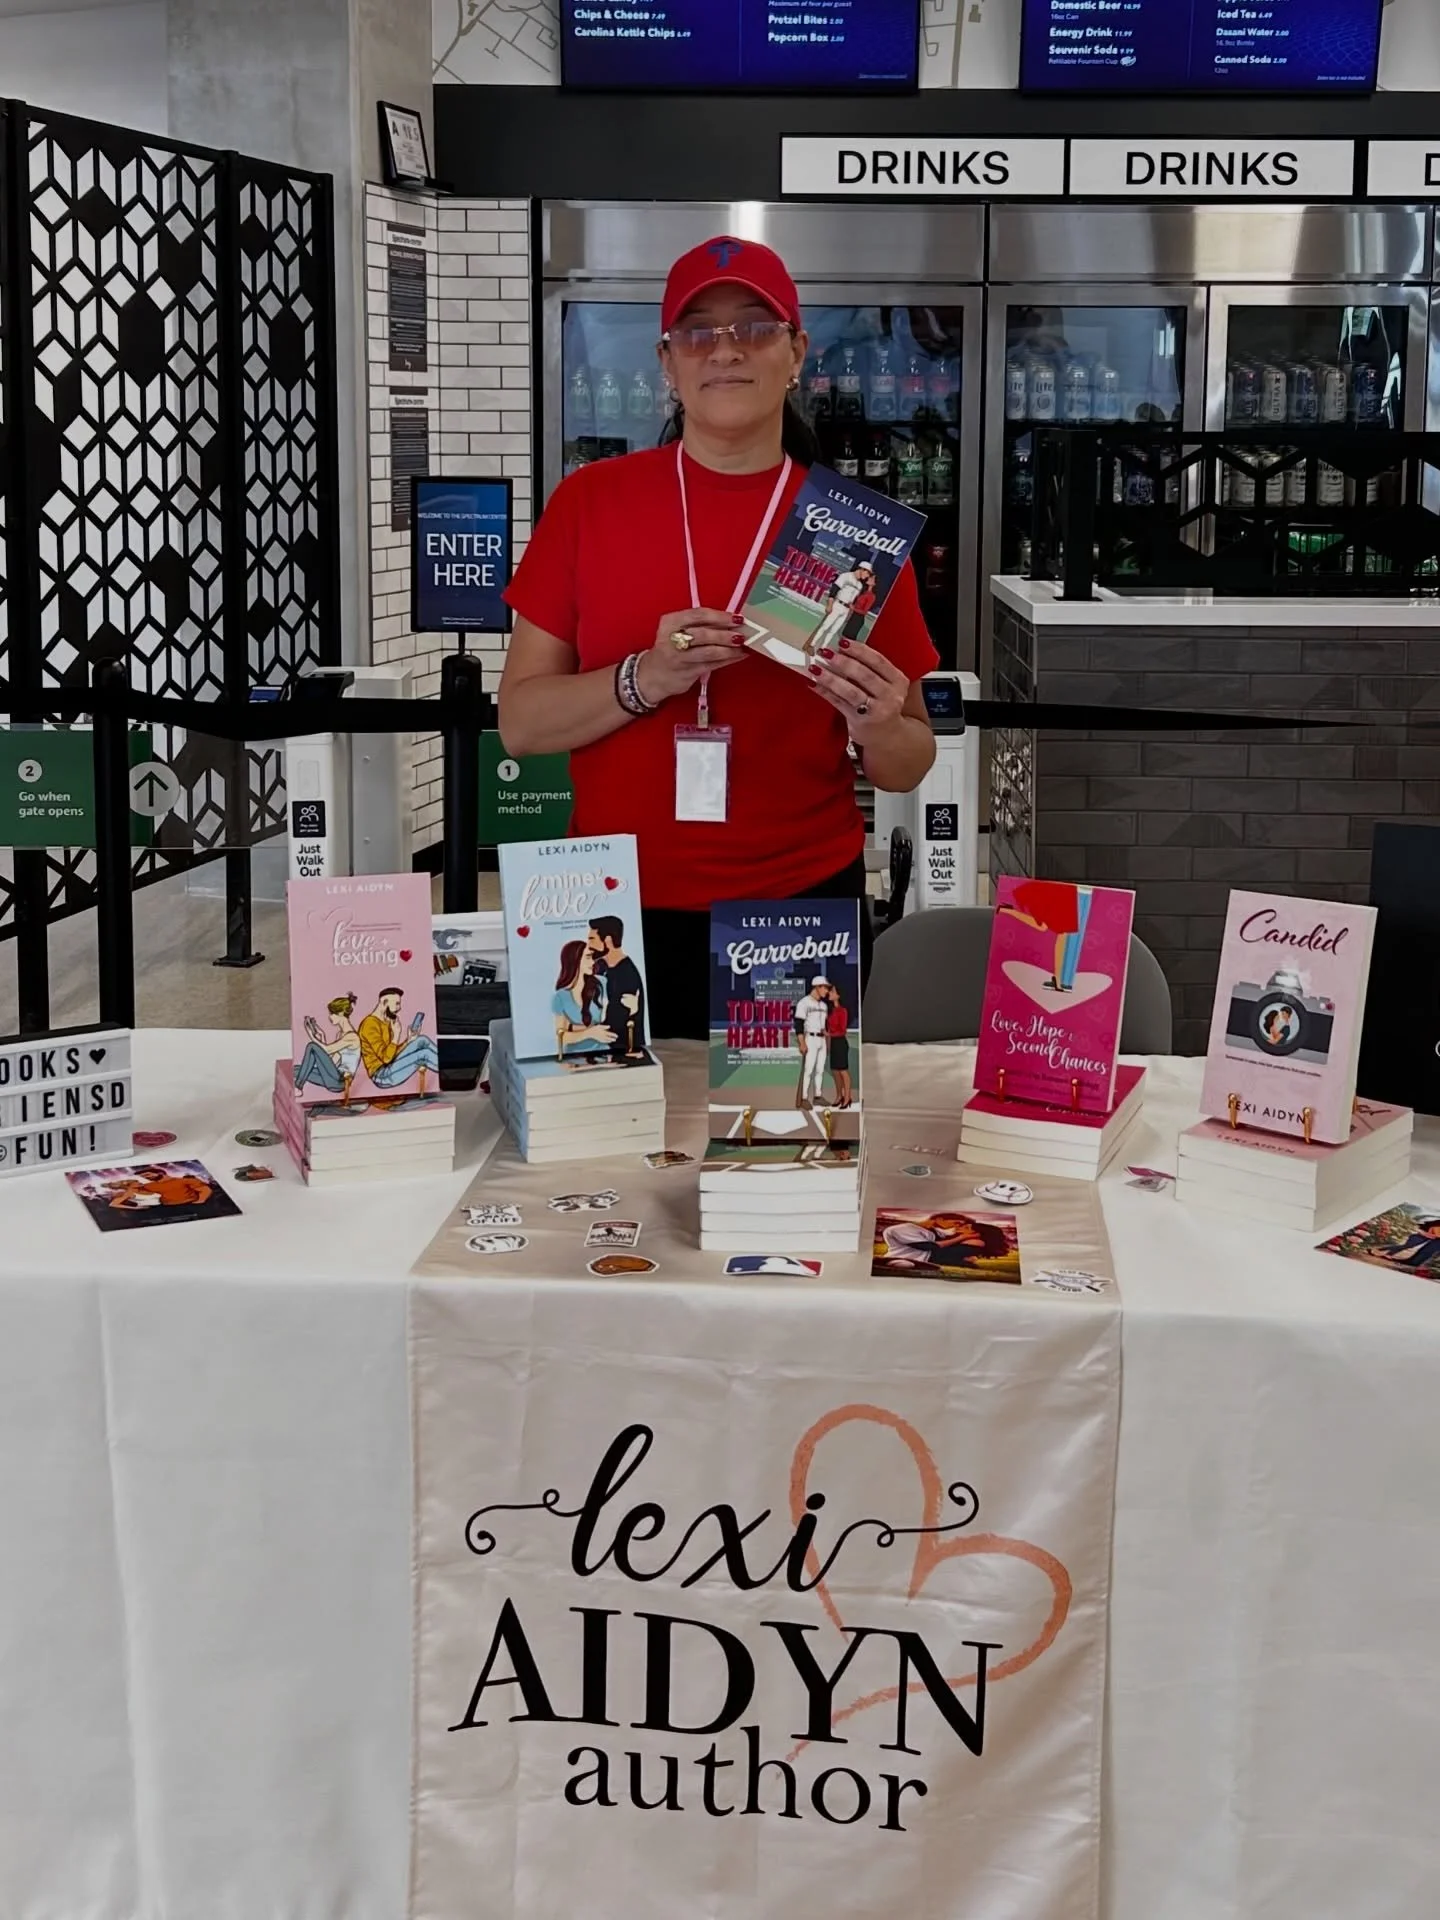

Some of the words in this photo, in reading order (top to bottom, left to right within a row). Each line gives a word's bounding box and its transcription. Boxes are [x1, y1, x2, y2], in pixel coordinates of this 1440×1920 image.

[1051, 0, 1096, 10] Domestic
[1098, 0, 1121, 10] Beer
[574, 9, 602, 21] Chips
[604, 10, 612, 19] &
[614, 10, 650, 20] Cheese
[768, 15, 801, 24] Pretzel
[804, 15, 827, 24] Bites
[1217, 9, 1238, 19] Iced
[1240, 10, 1256, 19] Tea
[575, 27, 614, 37] Carolina
[617, 28, 645, 37] Kettle
[648, 28, 675, 39] Chips
[768, 32, 808, 44] Popcorn
[810, 33, 828, 42] Box
[1050, 27, 1083, 39] Energy
[1086, 27, 1112, 37] Drink
[1216, 28, 1246, 36] Dasani
[1248, 28, 1273, 36] Water
[1049, 45, 1092, 54] Souvenir
[1093, 45, 1118, 54] Soda
[1214, 54, 1247, 63] Canned
[1249, 54, 1271, 63] Soda
[837, 150, 1009, 185] DRINKS
[1125, 151, 1299, 187] DRINKS
[828, 488, 853, 507] LEXI
[855, 502, 892, 526] AIDYN
[804, 503, 907, 557] Curveball
[426, 533, 502, 557] ENTER
[434, 563, 495, 587] HERE
[773, 566, 831, 604] HEART
[25, 765, 35, 777] 2
[504, 765, 512, 776] 1
[19, 791, 35, 802] Go
[38, 791, 71, 802] when
[498, 791, 519, 801] Use
[522, 791, 572, 803] payment
[19, 807, 45, 818] gate
[48, 807, 84, 818] opens
[498, 804, 542, 814] method
[298, 843, 321, 854] Just
[538, 845, 566, 857] LEXI
[570, 842, 611, 854] AIDYN
[930, 846, 953, 857] Just
[296, 855, 324, 866] Walk
[928, 857, 956, 868] Walk
[300, 866, 321, 877] Out
[931, 869, 953, 880] Out
[326, 884, 354, 894] LEXI
[357, 881, 394, 893] AIDYN
[521, 874, 599, 922] love
[743, 916, 771, 929] LEXI
[777, 914, 823, 928] AIDYN
[332, 919, 376, 950] love
[1239, 908, 1349, 956] Candid
[333, 947, 399, 968] texting
[726, 931, 850, 975] Curveball
[991, 1010, 1024, 1034] Love,
[1026, 1015, 1066, 1044] Hope
[727, 1025, 792, 1049] HEART
[1006, 1031, 1060, 1056] Second
[1048, 1043, 1109, 1075] Chances
[0, 1047, 80, 1085] OOKS
[0, 1081, 125, 1122] IENSD
[1262, 1107, 1306, 1124] AIDYN
[15, 1125, 96, 1165] FUN!
[470, 1217, 486, 1225] OF
[490, 1216, 518, 1225] LIFE
[465, 1423, 979, 1592] lexi
[448, 1597, 1004, 1758] AIDYN
[563, 1725, 928, 1832] author
